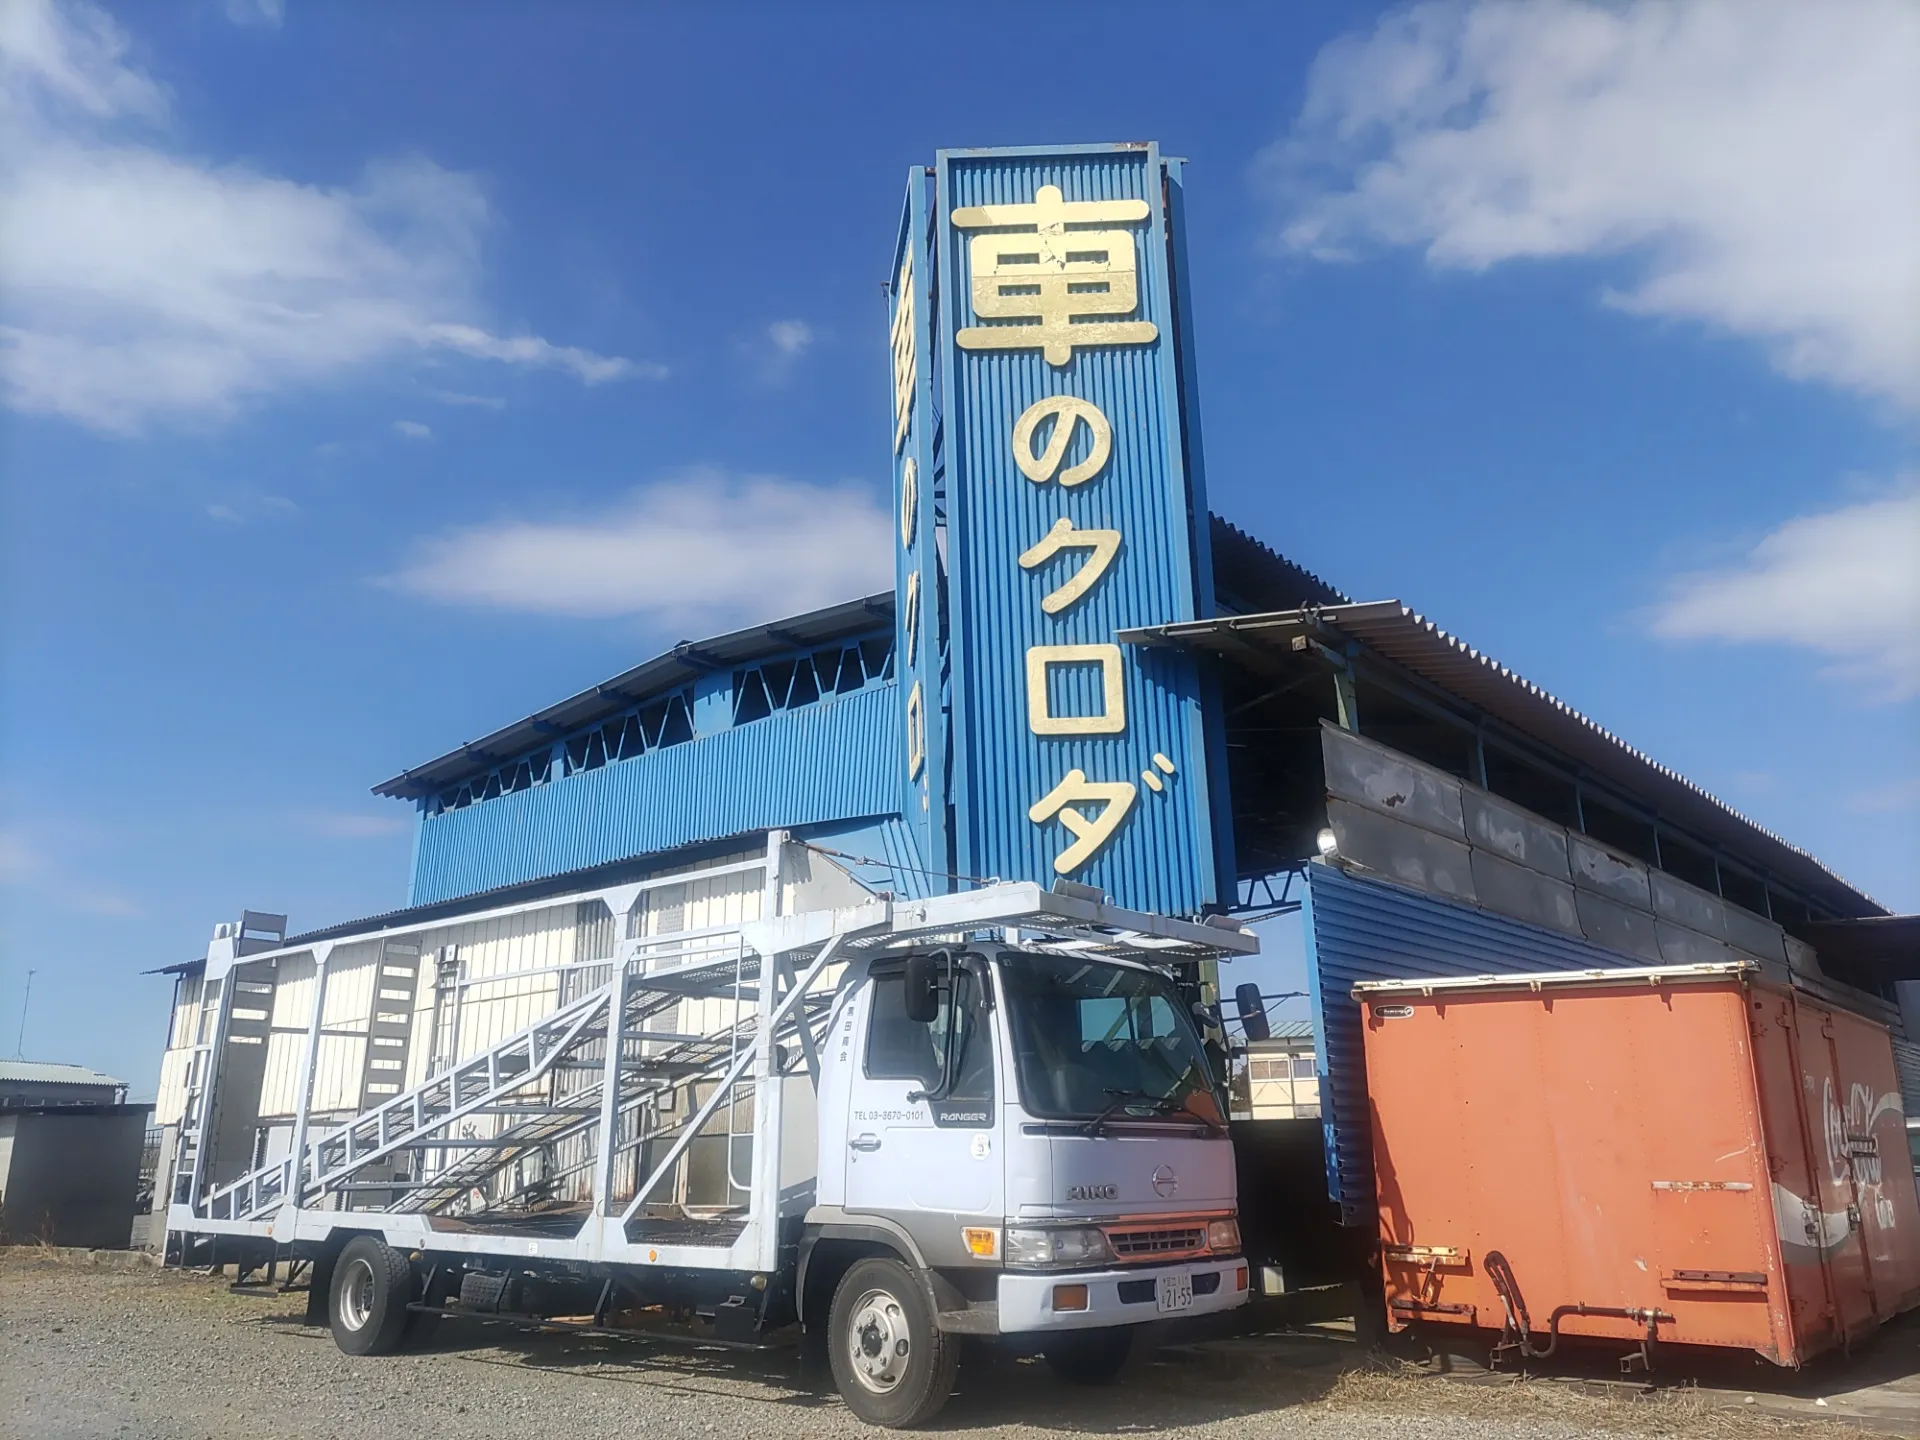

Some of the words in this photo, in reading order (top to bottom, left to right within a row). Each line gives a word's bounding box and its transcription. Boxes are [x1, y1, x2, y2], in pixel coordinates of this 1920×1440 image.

[951, 185, 1175, 874] 車のクロダ
[854, 1111, 867, 1120] TEL
[940, 1112, 987, 1121] RANGER
[1066, 1184, 1119, 1201] HINO
